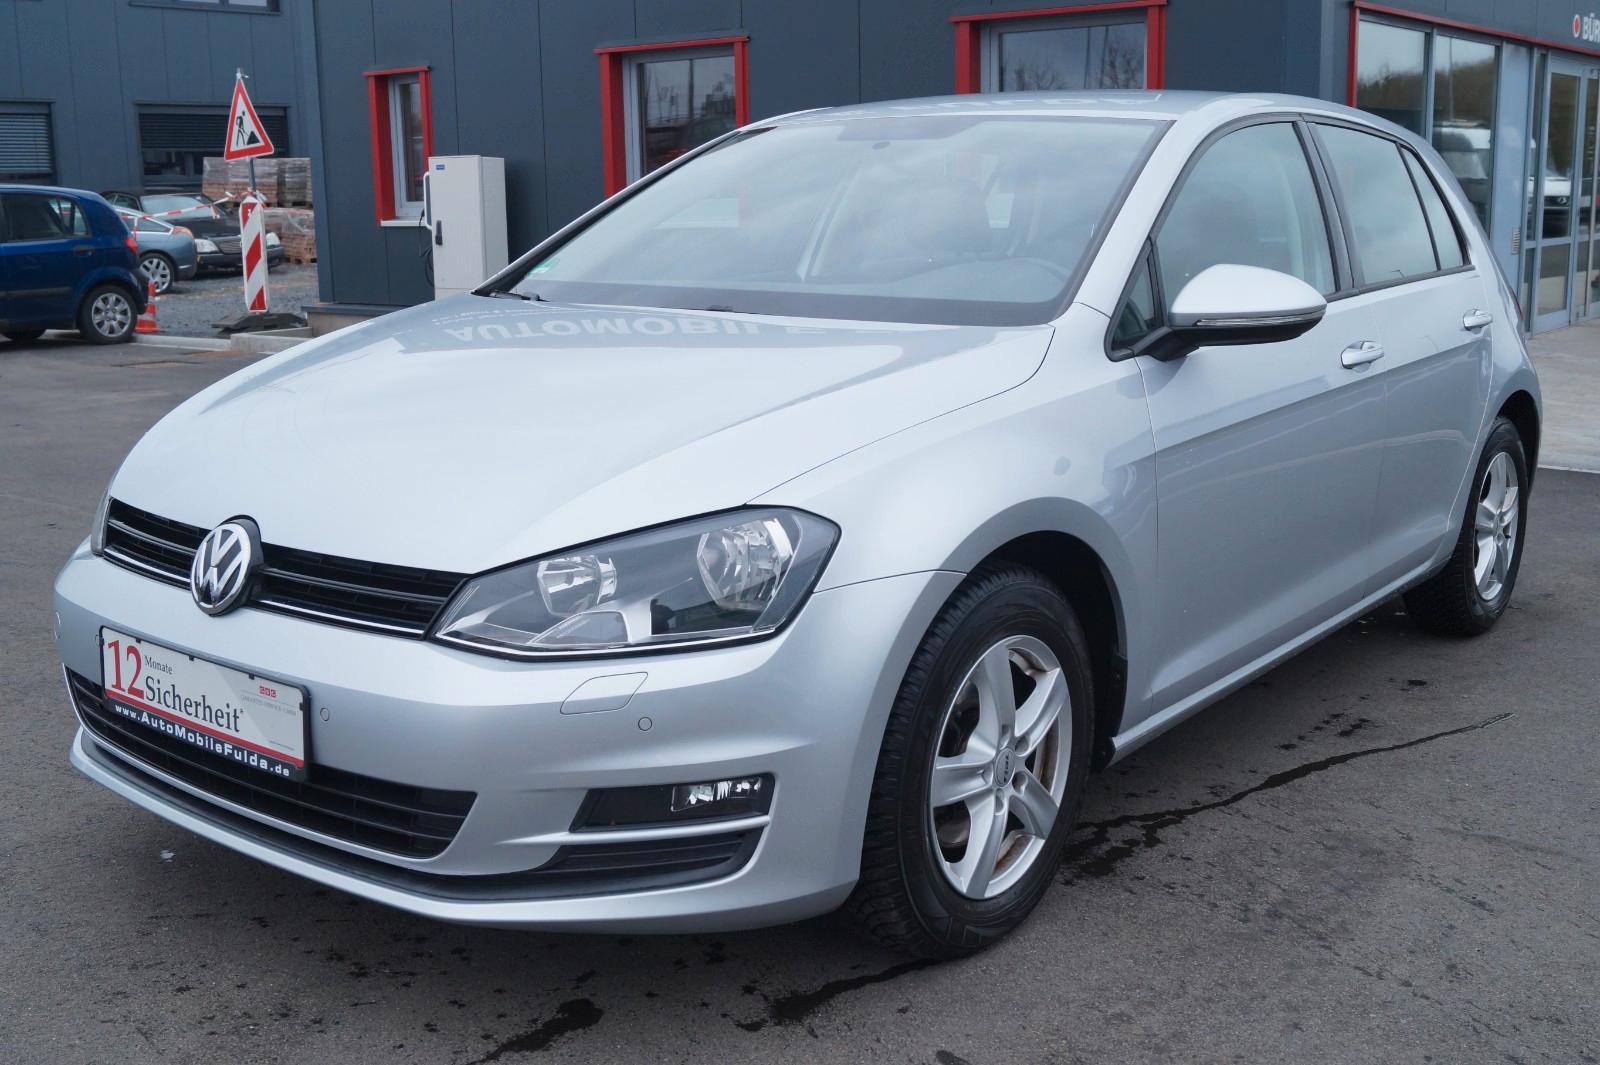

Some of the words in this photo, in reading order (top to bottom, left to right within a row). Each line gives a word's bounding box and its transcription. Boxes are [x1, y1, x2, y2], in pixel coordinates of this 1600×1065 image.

[191, 523, 251, 608] VW
[107, 639, 145, 700] 12
[144, 655, 173, 675] Monate
[115, 704, 290, 777] www.AutoMobileFulda.de
